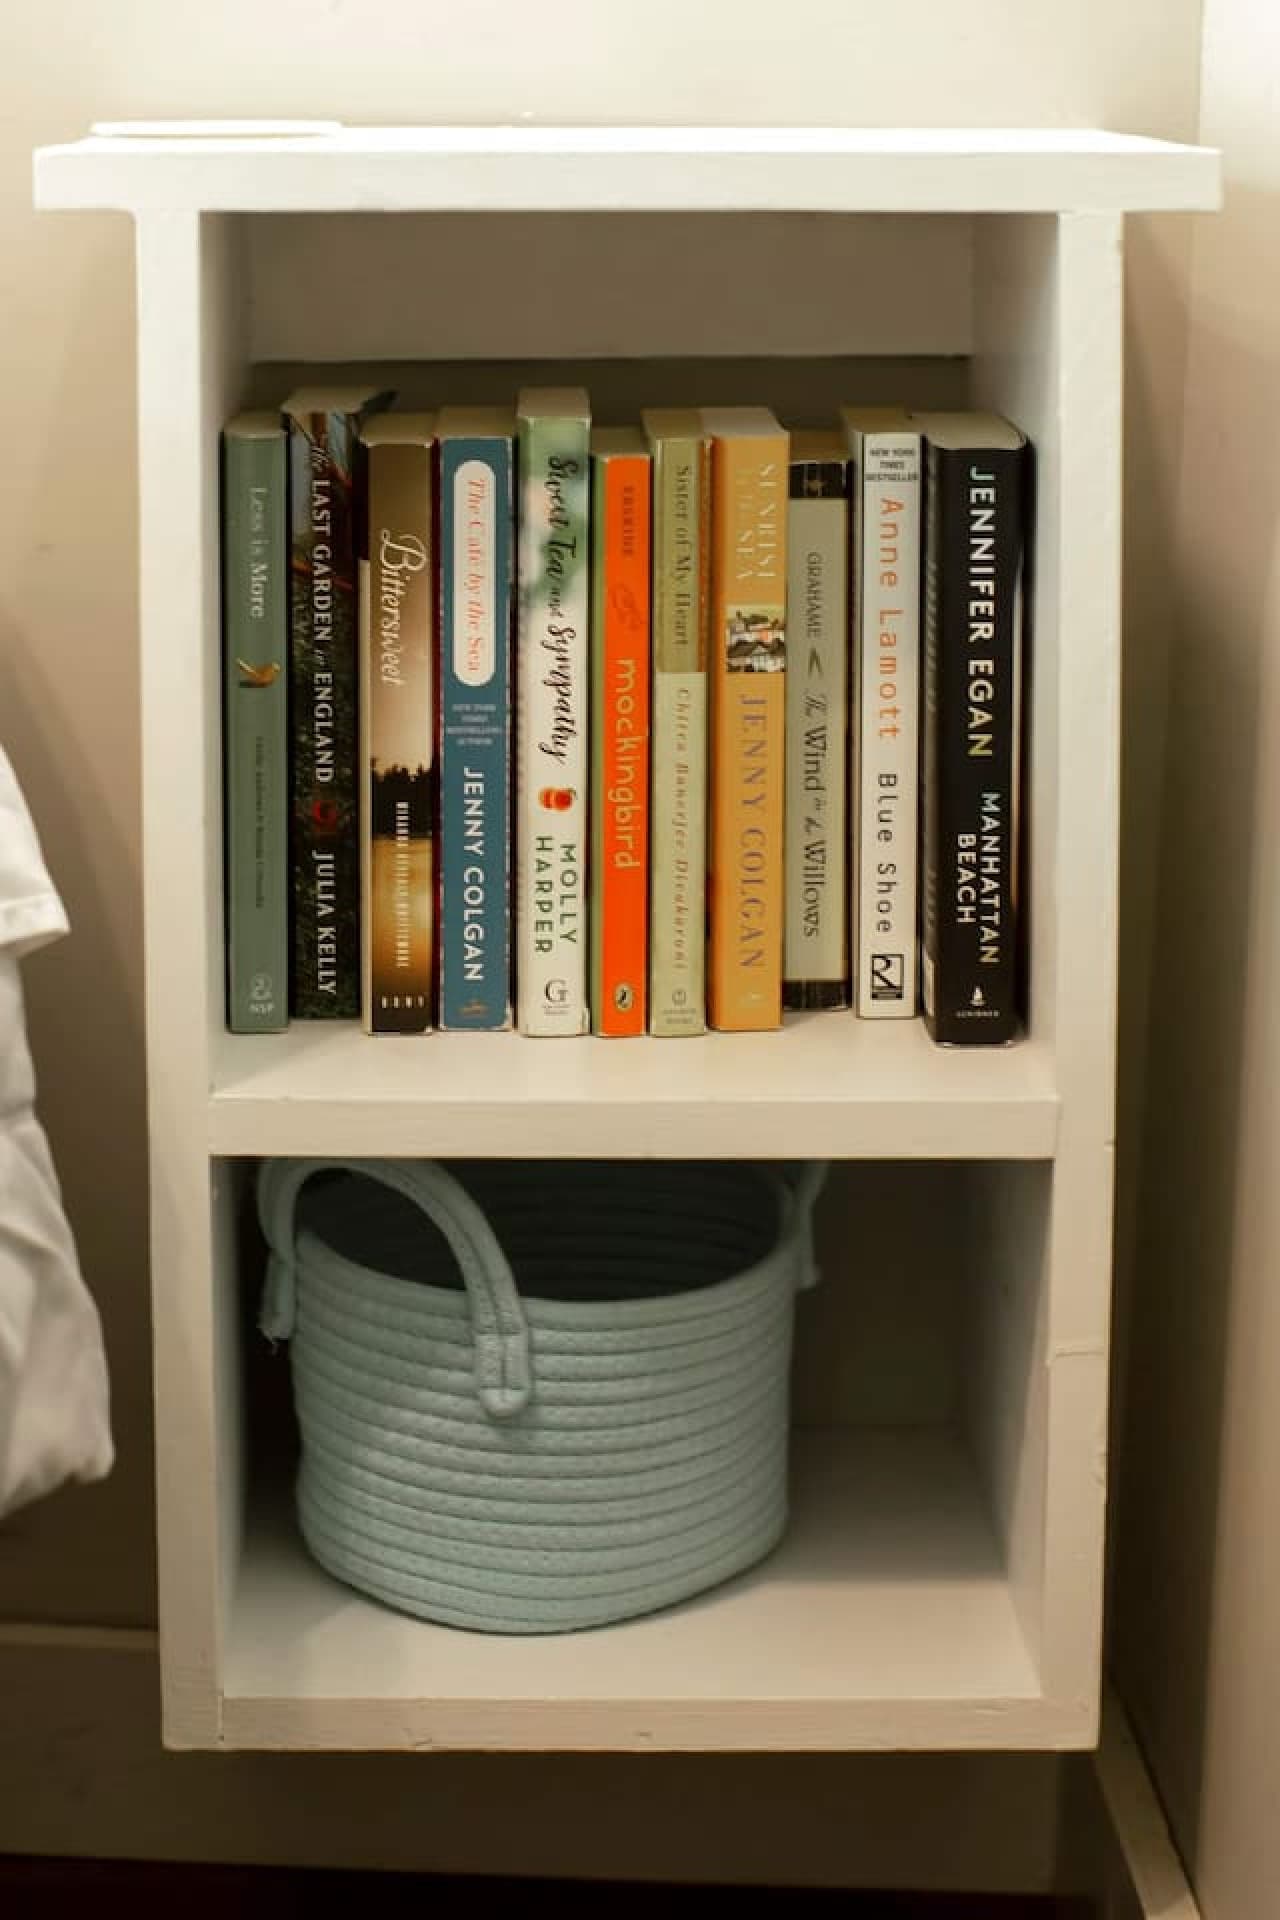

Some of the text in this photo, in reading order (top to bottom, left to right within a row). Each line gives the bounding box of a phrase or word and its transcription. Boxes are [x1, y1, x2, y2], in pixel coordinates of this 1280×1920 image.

[312, 480, 331, 536] LAST
[466, 479, 486, 514] The
[544, 456, 579, 530] Sweet
[251, 562, 267, 619] More
[312, 544, 333, 641] GARDEN
[463, 573, 486, 593] by
[547, 536, 577, 578] Tea
[671, 465, 691, 646] Sister of My Heart
[807, 551, 823, 639] GRAHAME
[380, 528, 427, 686] Bittersweet
[467, 600, 487, 630] the
[468, 637, 486, 672] Sea
[879, 498, 904, 740] Anne Lamott
[966, 465, 996, 757] JENNIFER EGAN
[314, 672, 334, 783] ENGLAND
[538, 623, 578, 766] Sympathy
[608, 658, 641, 869] mockingbird
[804, 725, 827, 791] Wind
[464, 766, 485, 981] JENNY COLGAN
[739, 695, 766, 969] JENNY COLGAN
[877, 773, 899, 933] Blue Shoe
[957, 833, 977, 923] BEACH
[979, 791, 1001, 963] MANHATTAN
[312, 850, 336, 995] JULIA KELLY
[535, 836, 553, 953] HARPER
[560, 843, 577, 944] MOLLY
[803, 840, 827, 938] Willows
